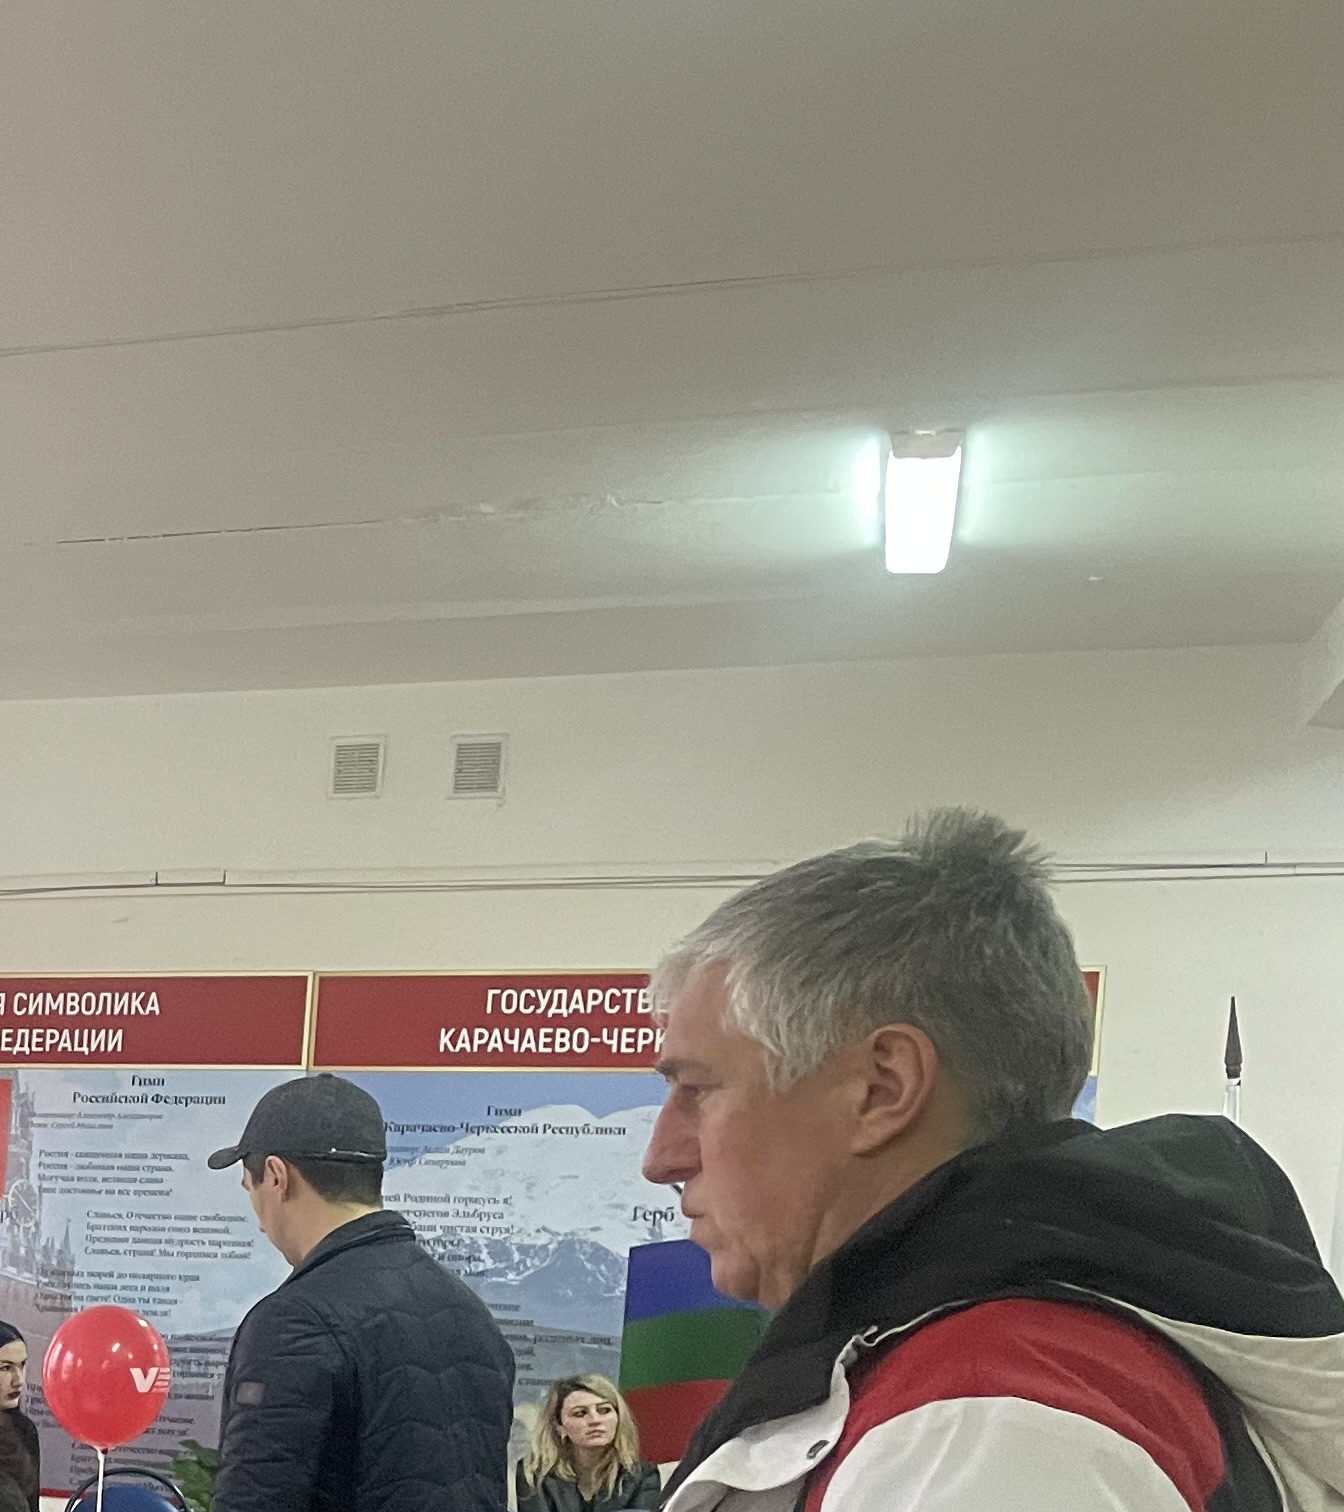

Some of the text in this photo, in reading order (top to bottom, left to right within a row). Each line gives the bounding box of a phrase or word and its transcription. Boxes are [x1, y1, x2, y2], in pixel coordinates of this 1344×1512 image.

[13, 991, 161, 1016] СИМВОЛИКА
[73, 1091, 226, 1107] Российской Федерации
[486, 1105, 522, 1117] Гимн
[543, 1122, 627, 1138] Республики
[451, 1207, 504, 1223] Эльбруса
[632, 1206, 675, 1226] Герб
